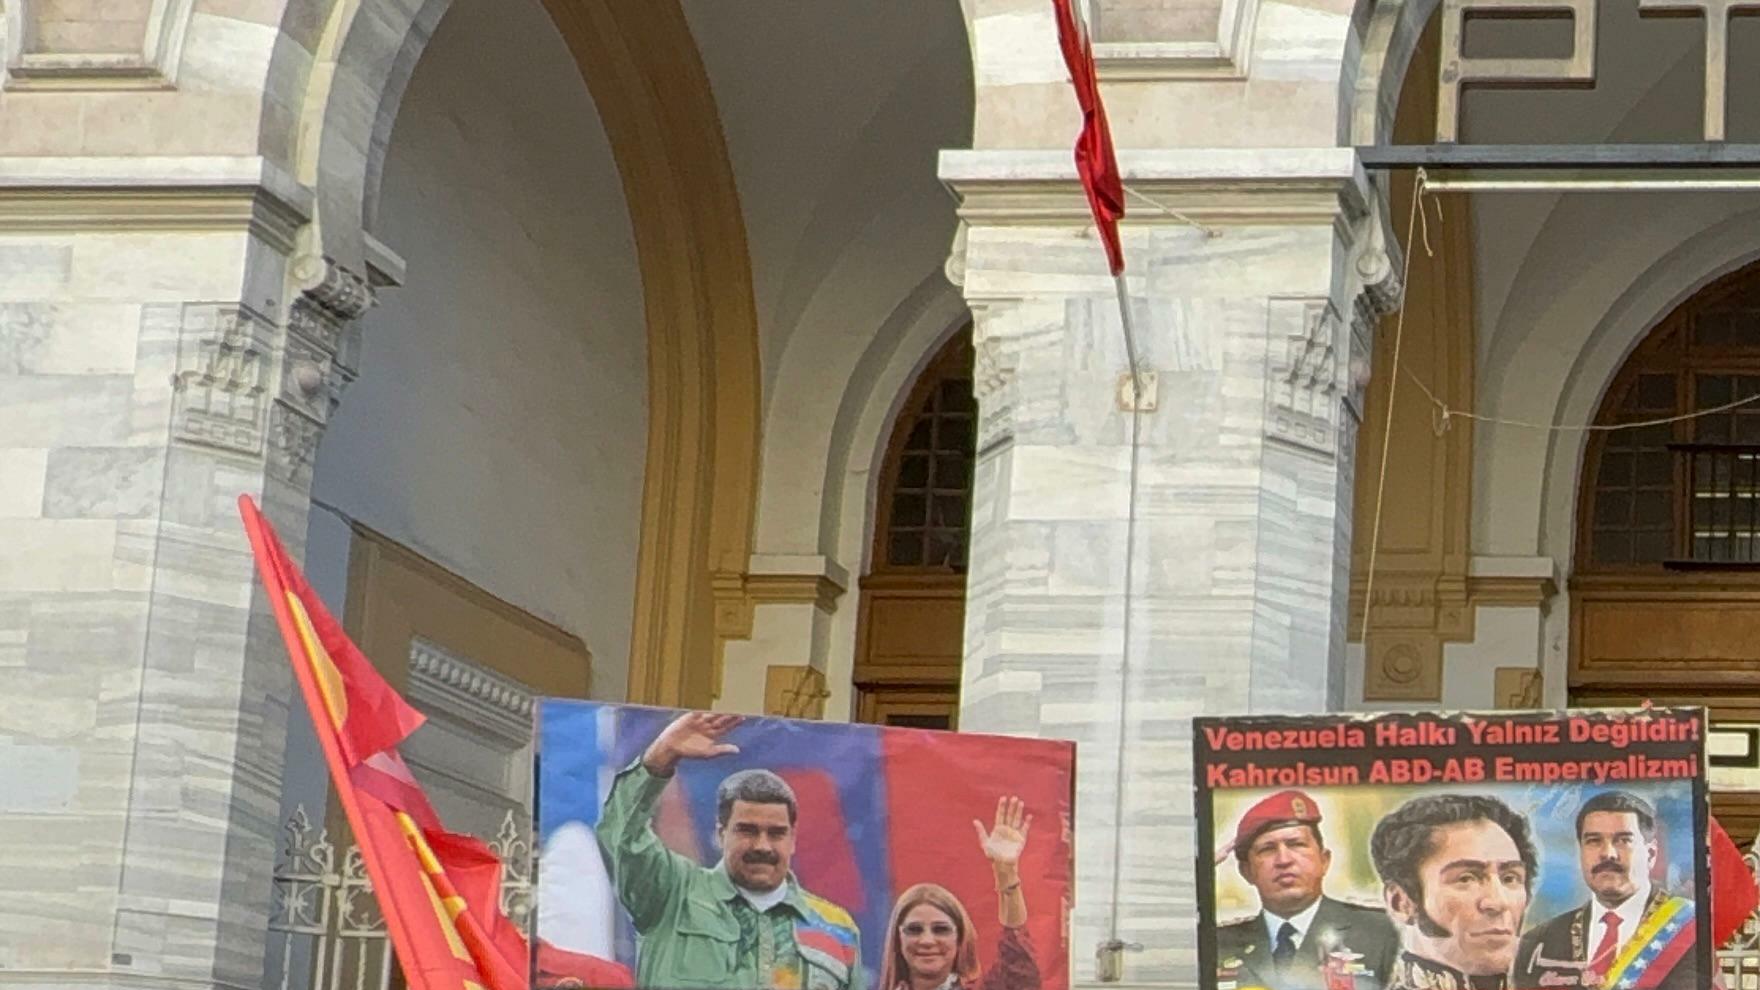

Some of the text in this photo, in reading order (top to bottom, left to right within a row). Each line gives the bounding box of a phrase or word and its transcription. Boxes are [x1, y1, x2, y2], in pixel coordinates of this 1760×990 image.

[1205, 716, 1700, 751] Venezuela Halkı Yalnız Değildir!
[1205, 762, 1360, 788] Kahrolsun
[1368, 757, 1486, 785] ABD-AB
[1494, 753, 1698, 783] Emperyalizmi
